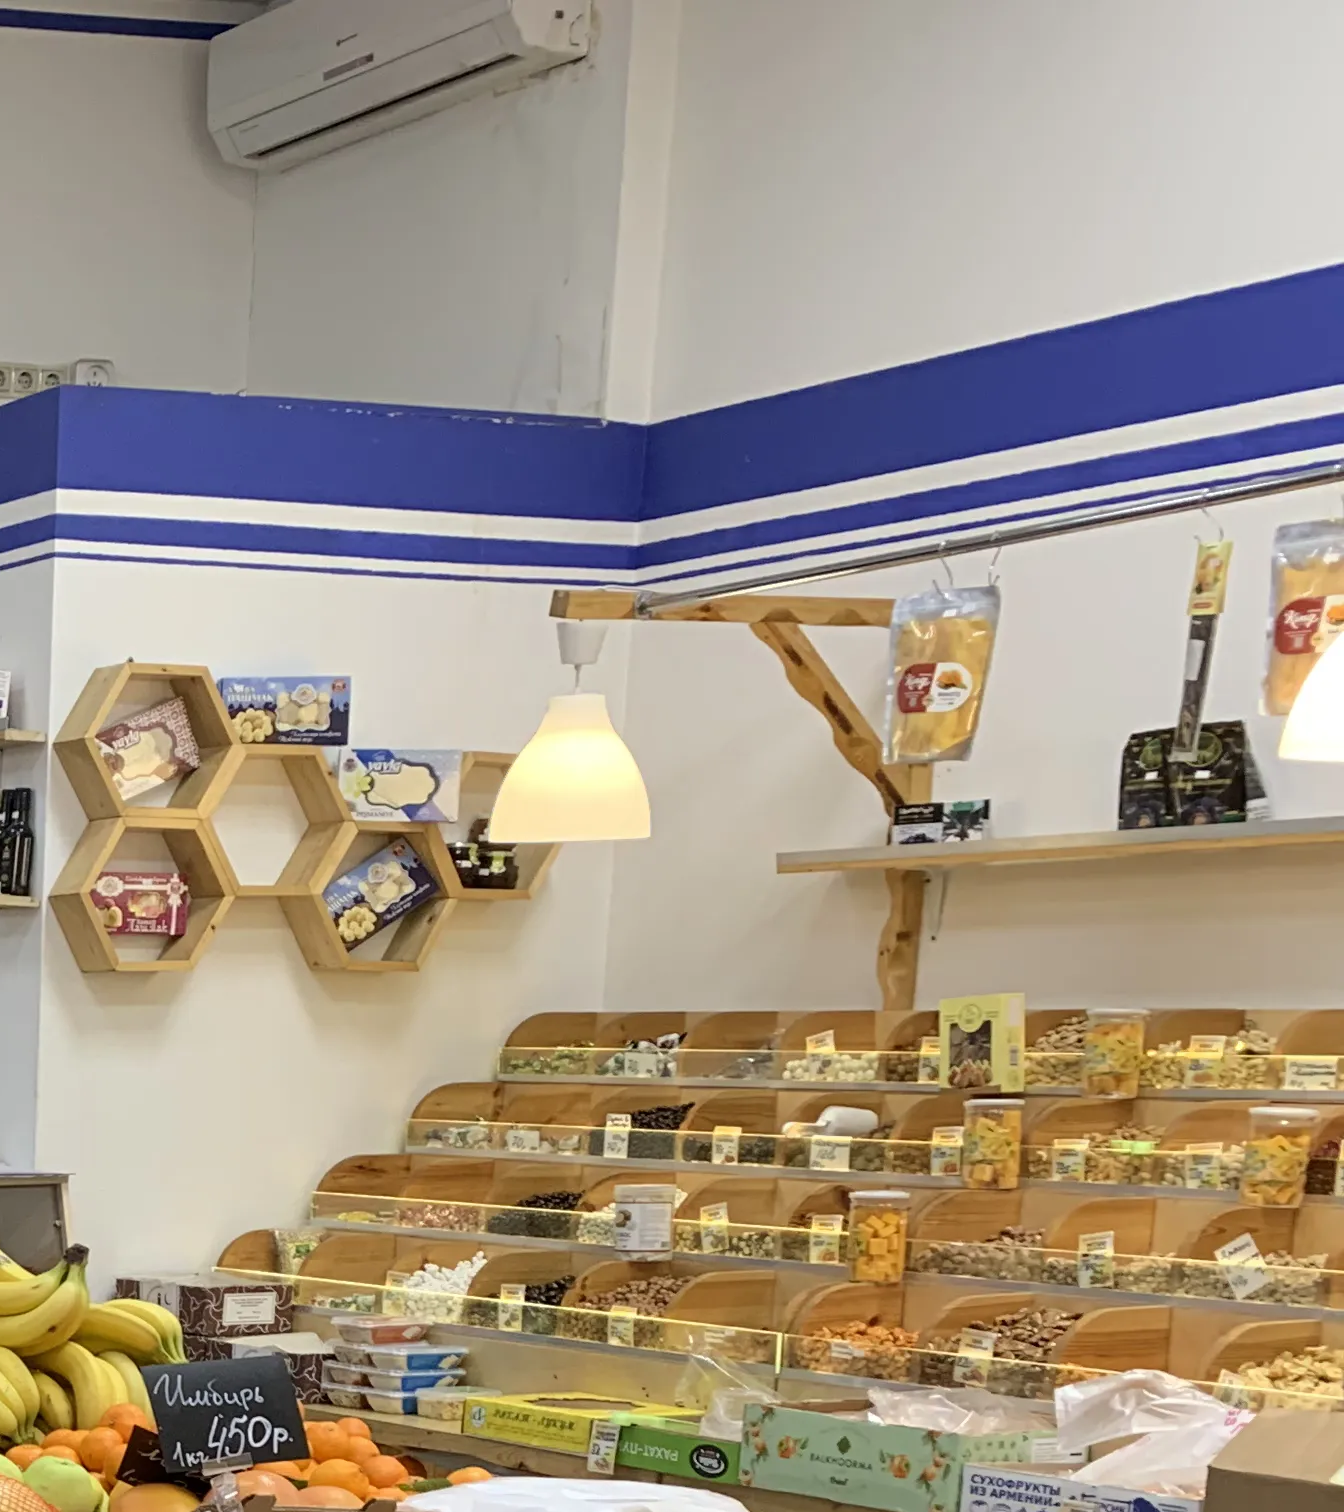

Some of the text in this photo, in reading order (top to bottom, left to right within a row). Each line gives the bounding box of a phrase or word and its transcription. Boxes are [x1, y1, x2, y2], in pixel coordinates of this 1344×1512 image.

[153, 1373, 265, 1411] Имбирь
[969, 1485, 1054, 1508] ИЗ АРМЕНИИ
[970, 1473, 1062, 1497] СУХОФРУКТЫ
